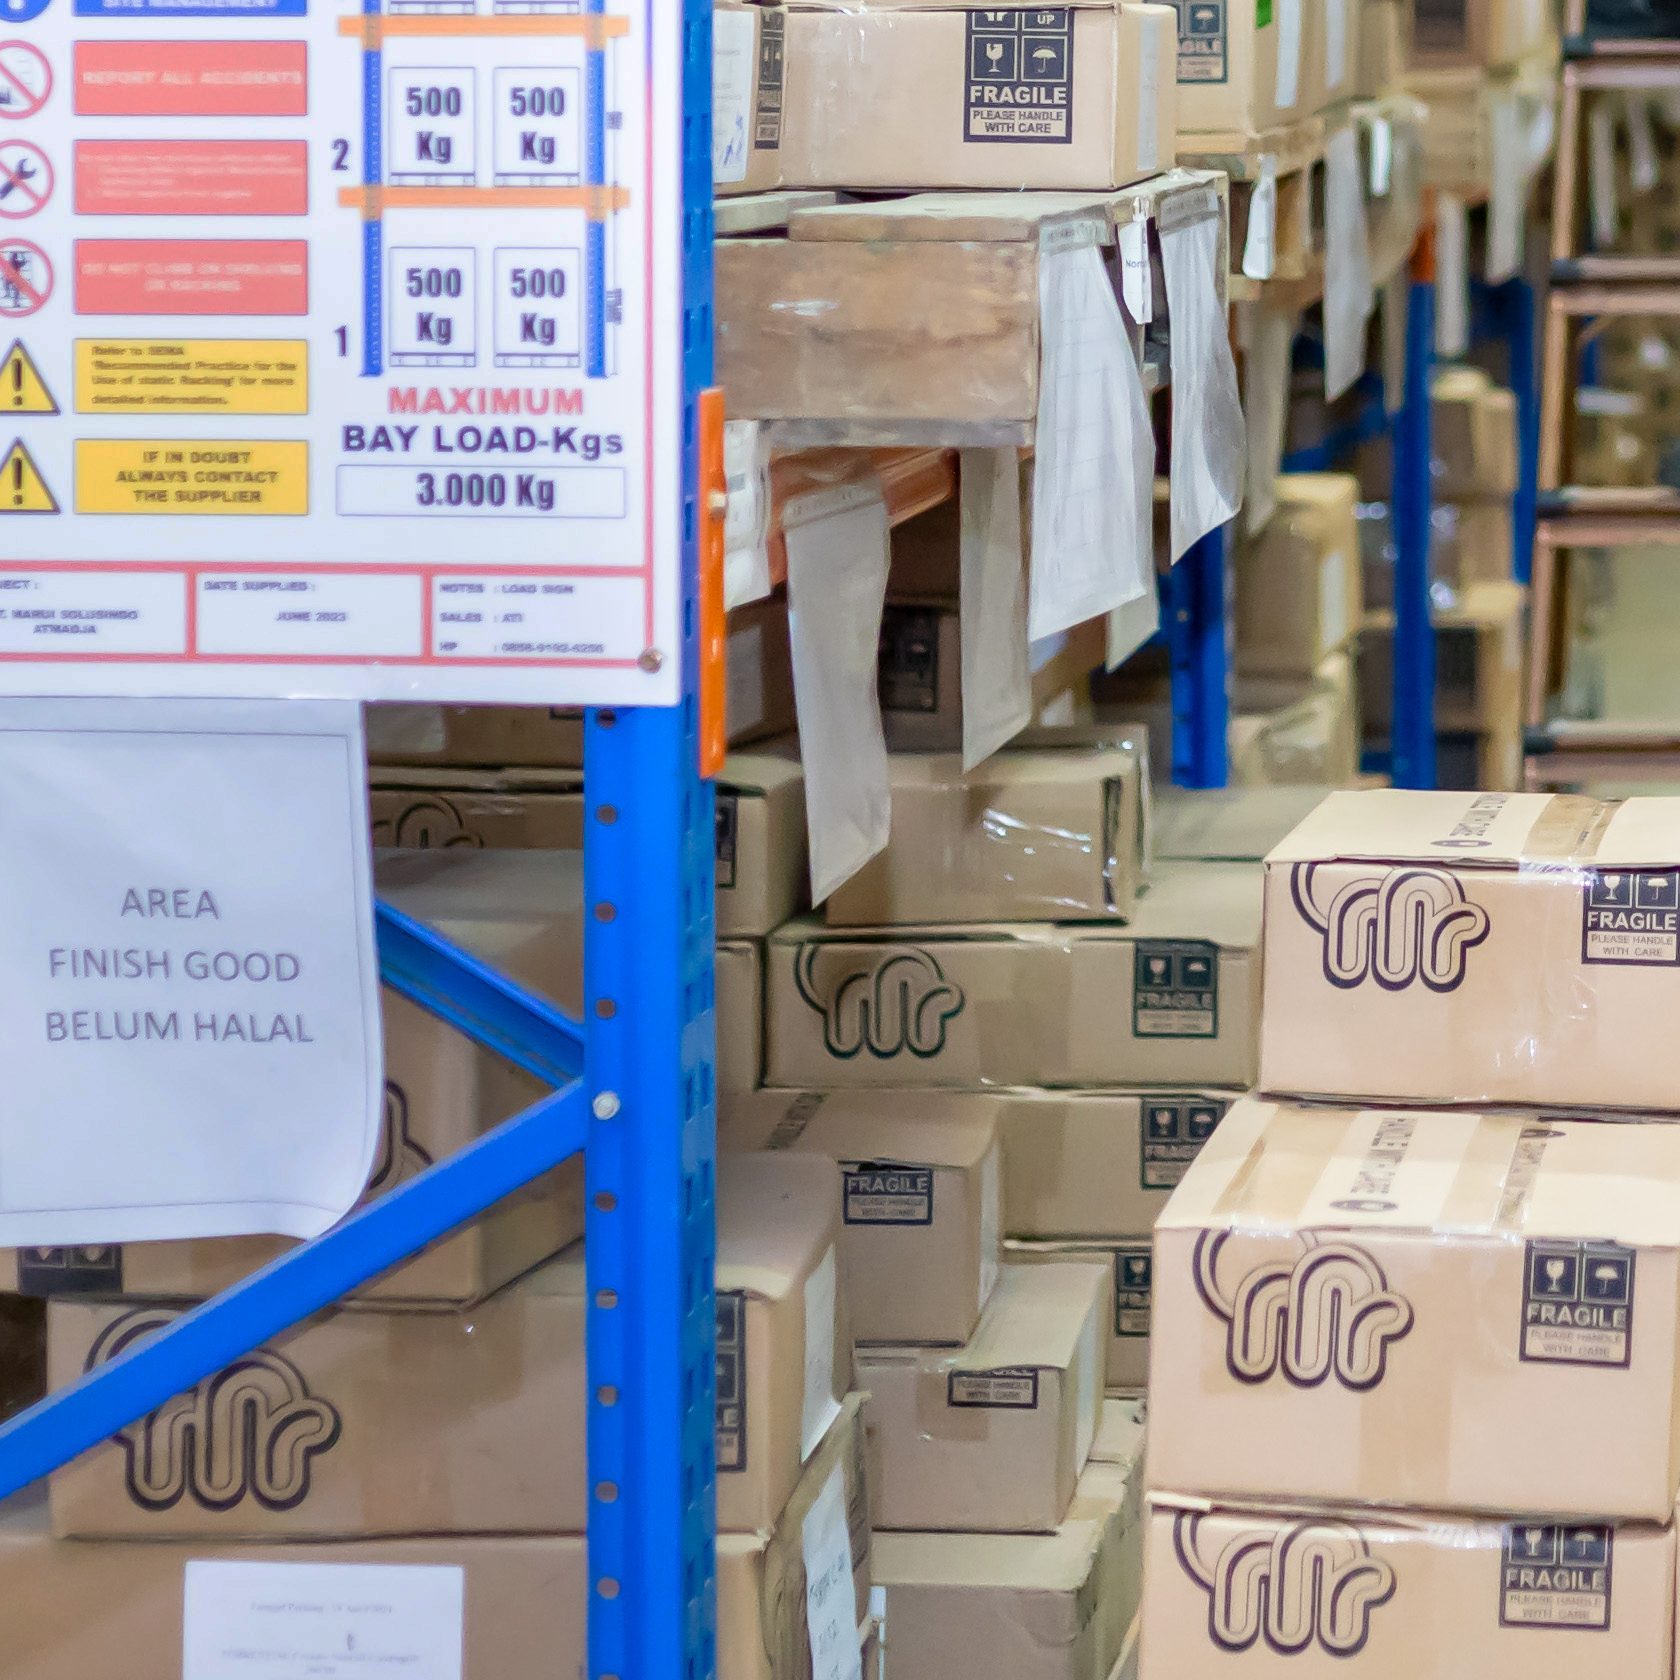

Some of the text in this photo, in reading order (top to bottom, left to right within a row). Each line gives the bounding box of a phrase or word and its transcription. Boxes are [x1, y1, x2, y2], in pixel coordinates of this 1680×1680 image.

[1036, 14, 1055, 24] UP
[82, 71, 302, 85] REPORT ALL ACCIDENTS
[406, 86, 565, 117] 500 500
[970, 86, 1067, 105] FRAGILE
[972, 110, 1063, 121] PLEASE HANDLE
[984, 122, 1052, 134] WITH CARE
[330, 138, 349, 172] 2
[417, 131, 555, 164] Kg Kg
[406, 267, 565, 298] 500 500
[417, 312, 555, 346] Kg Kg
[334, 326, 348, 357] 1
[387, 387, 584, 415] MAXIMUM
[342, 424, 623, 461] BAY LOAD-Kgs
[143, 451, 251, 464] IF IN DOUBT
[116, 471, 279, 483] ALWAYS CONTACT
[133, 490, 262, 503] THE SUPPLIER
[416, 473, 555, 511] 3.000 Kg
[204, 580, 309, 591] DATE SUPPLIED
[440, 583, 575, 594] NOTES LOAD SIGN
[275, 611, 311, 621] JUNE
[440, 612, 482, 623] SALES
[121, 888, 220, 920] AREA
[1587, 911, 1677, 931] FRAGILE
[1590, 933, 1673, 945] PLEASE HANDLE
[1602, 946, 1662, 958] WITH CARE
[48, 948, 301, 983] FINISH GOOD
[1139, 992, 1213, 1009] FRAGILE
[46, 1010, 315, 1044] BELUM HALAL
[847, 1176, 929, 1192] FRAGILE
[1526, 1304, 1627, 1329] FRAGILE
[1542, 1342, 1610, 1357] WITH CARE
[1504, 1568, 1606, 1590] FRAGILE
[1510, 1593, 1552, 1605] PLEASE
[1522, 1608, 1589, 1620] WITH CARE
